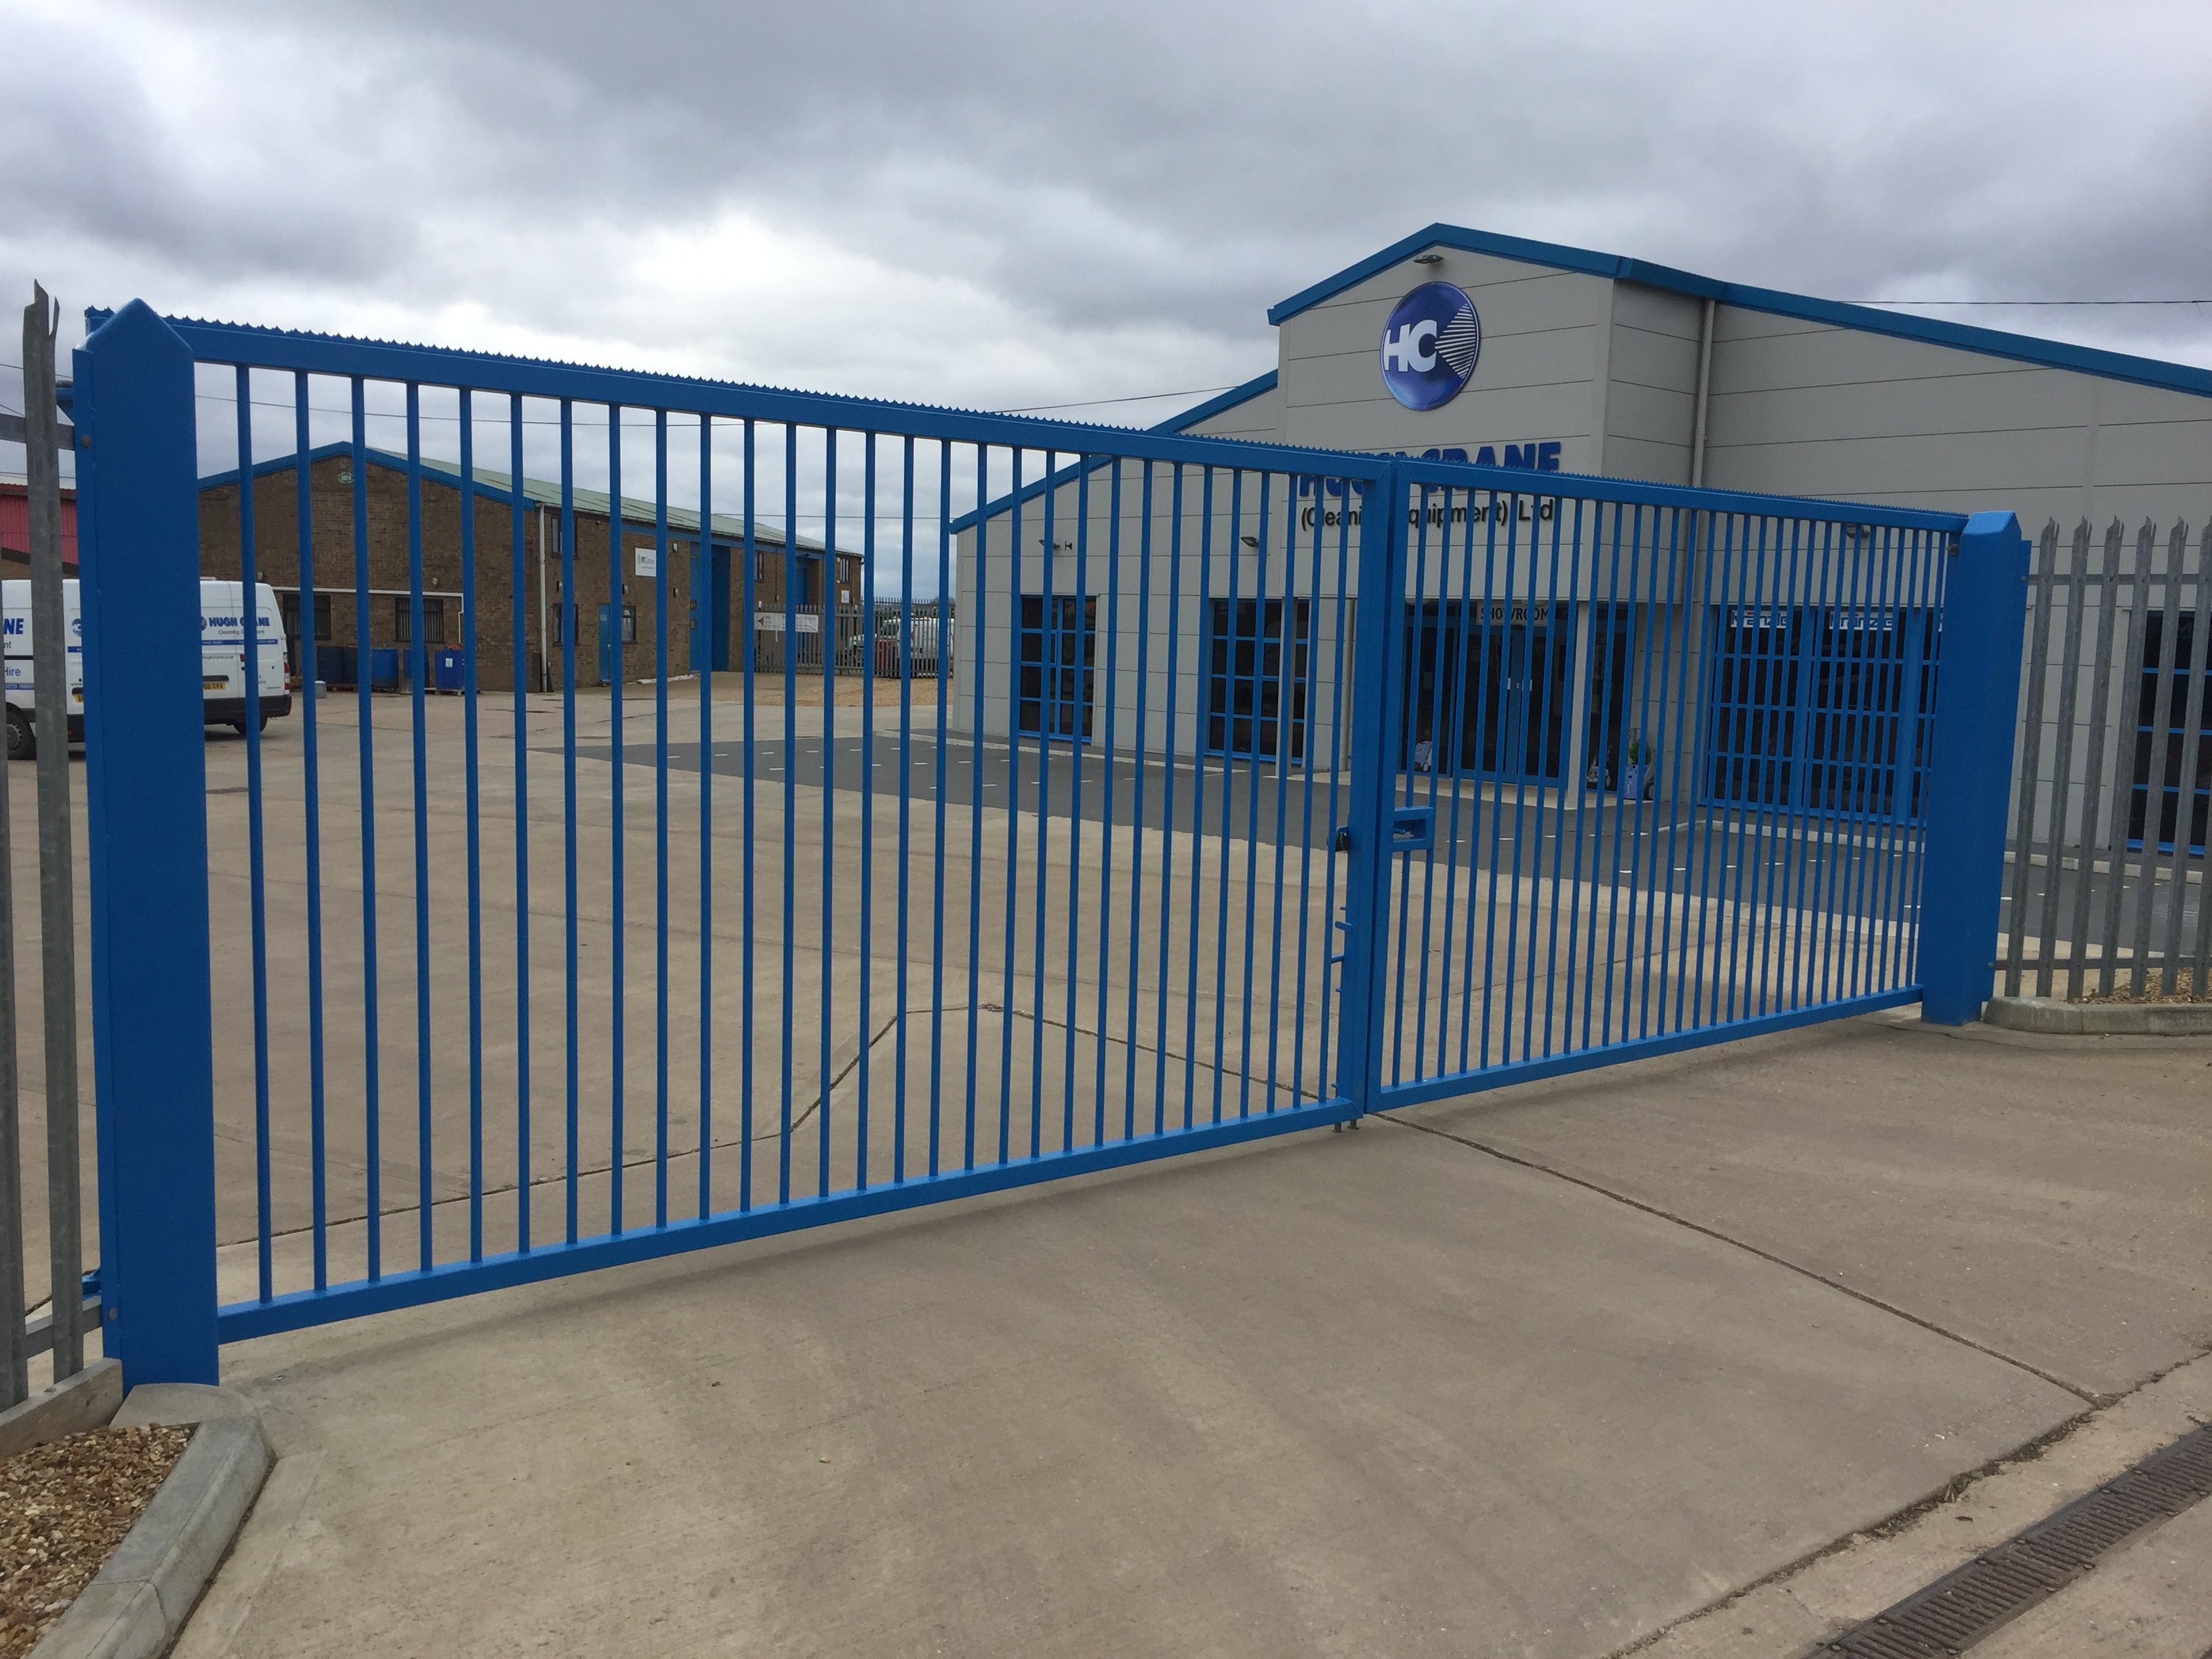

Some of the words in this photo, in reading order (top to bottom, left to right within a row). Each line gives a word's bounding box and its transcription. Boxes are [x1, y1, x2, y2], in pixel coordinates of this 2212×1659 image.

[1384, 319, 1437, 373] HC
[1408, 499, 1508, 529] quipment)
[1519, 499, 1554, 521] Ld
[239, 616, 270, 627] CNE
